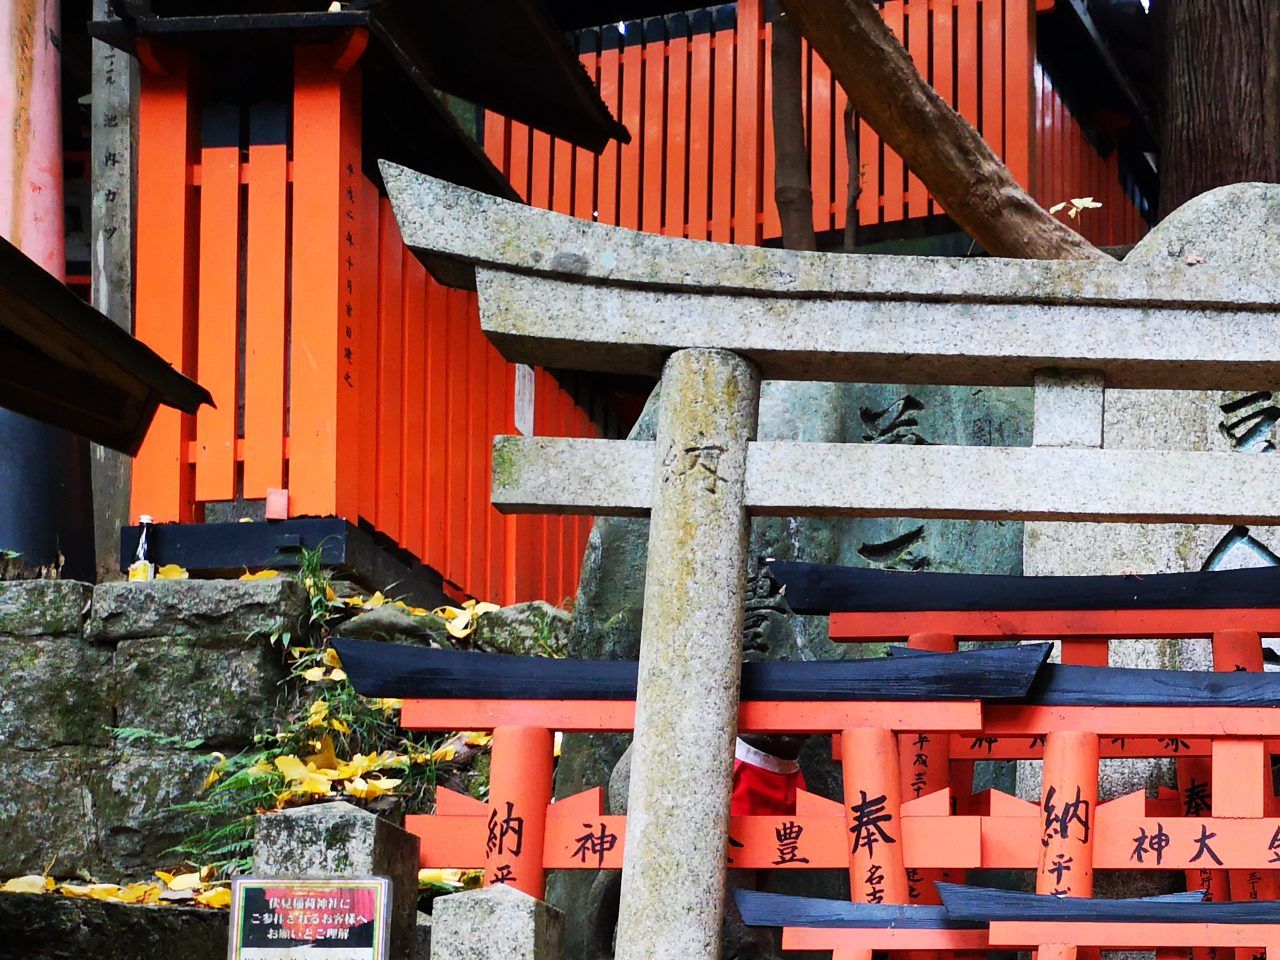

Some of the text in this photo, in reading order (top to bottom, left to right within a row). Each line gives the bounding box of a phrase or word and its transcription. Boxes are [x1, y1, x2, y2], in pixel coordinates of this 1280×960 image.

[487, 801, 523, 858] 納
[849, 789, 896, 860] 奉
[1041, 784, 1089, 846] 納
